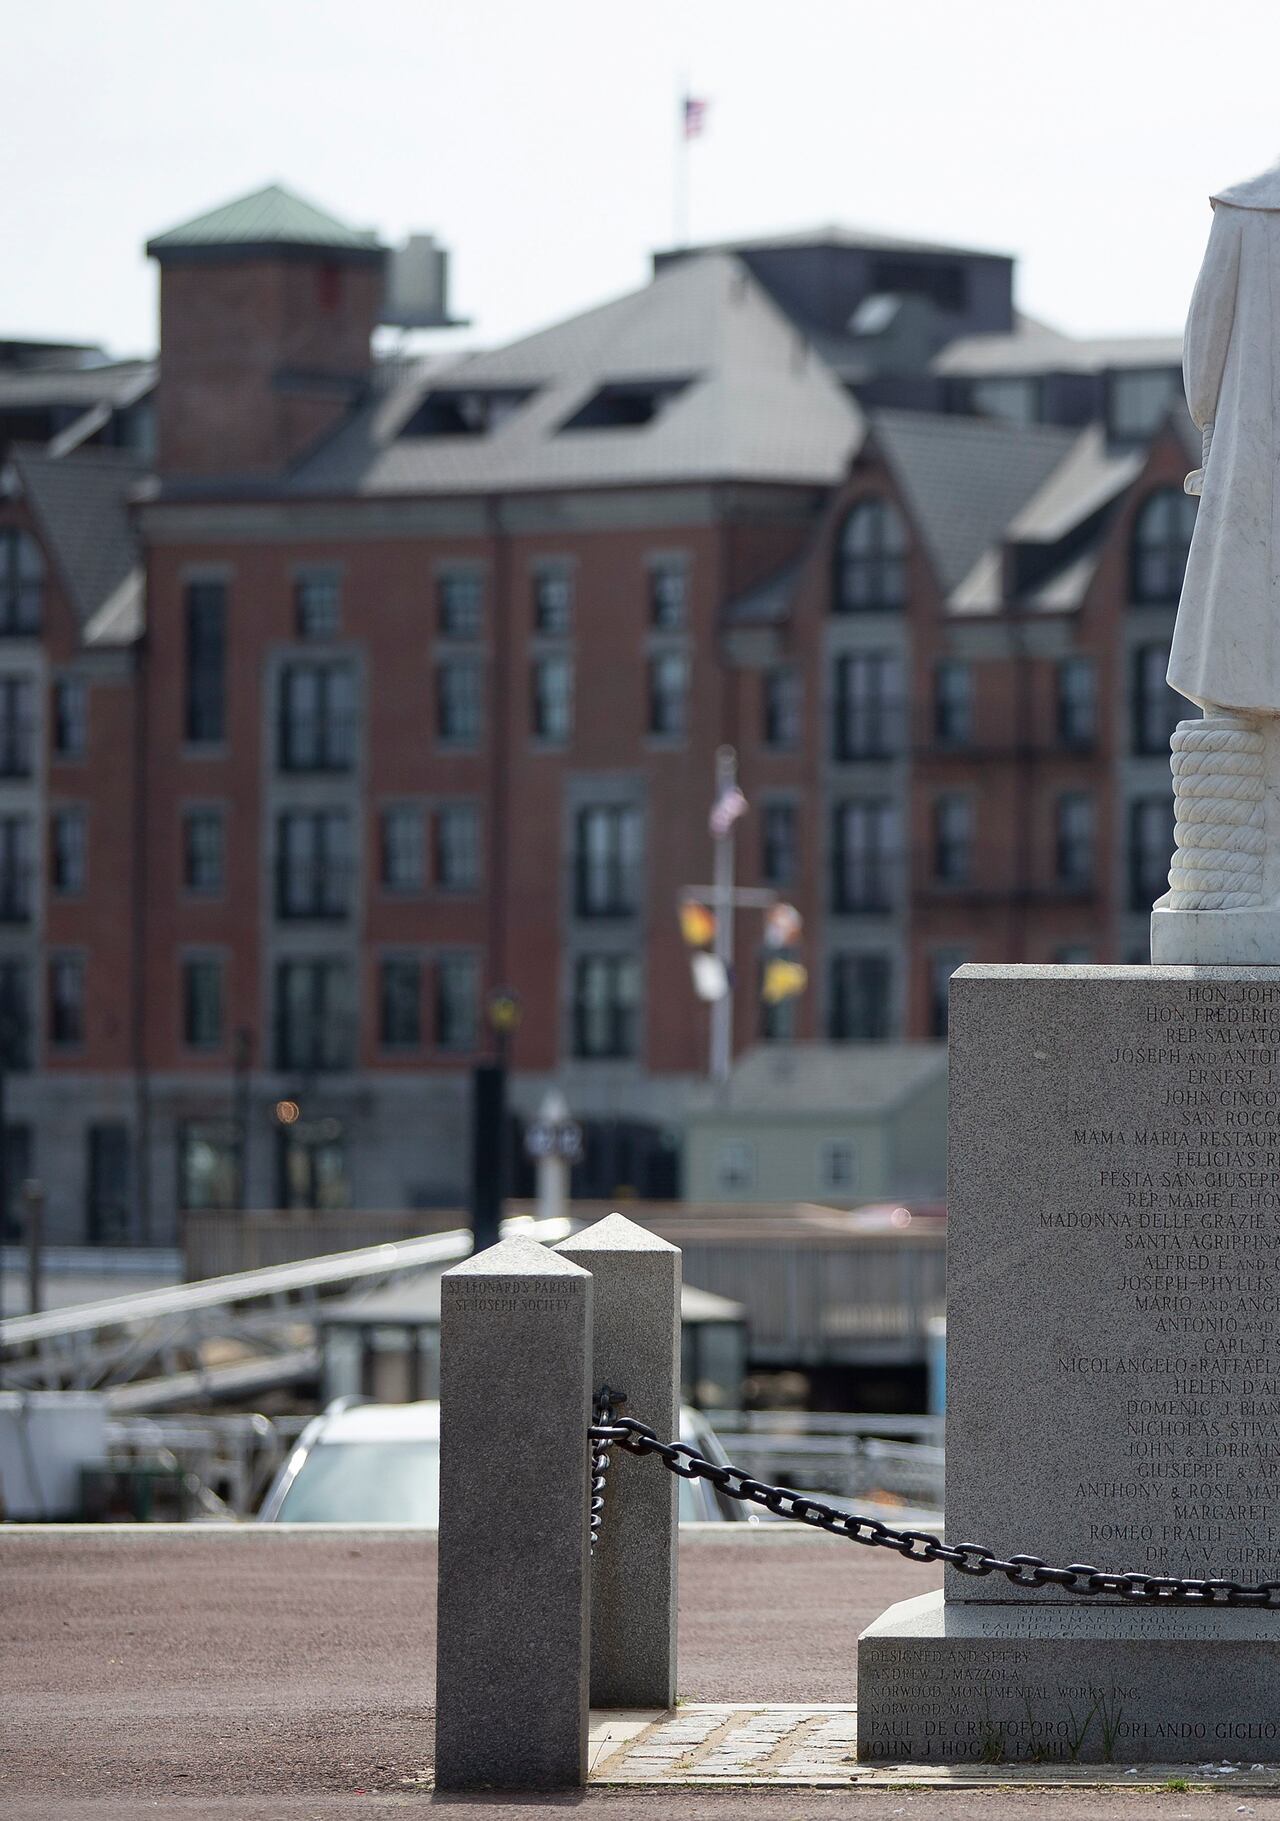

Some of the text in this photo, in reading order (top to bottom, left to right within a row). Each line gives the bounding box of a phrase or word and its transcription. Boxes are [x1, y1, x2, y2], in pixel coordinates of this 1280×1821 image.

[1110, 1049, 1180, 1064] JOSEPH
[1188, 1070, 1254, 1084] ERNEST
[1161, 1091, 1211, 1106] JOHN
[1182, 1111, 1216, 1126] SAN
[1074, 1130, 1126, 1145] MAMA
[1134, 1131, 1189, 1145] MARIA
[1176, 1152, 1256, 1167] FELICIA'S
[1100, 1172, 1153, 1187] FESTA
[1162, 1172, 1195, 1187] SAN
[1169, 1193, 1223, 1208] MARIE
[1040, 1213, 1131, 1228] MADONNA
[1140, 1214, 1194, 1229] DELLE
[1201, 1214, 1266, 1229] GRAZIE
[1125, 1235, 1181, 1249] SANTA
[1144, 1255, 1209, 1270] ALFRED
[535, 1282, 577, 1294] PARISH
[472, 1300, 516, 1311] JOSEPH
[522, 1300, 571, 1311] SOCIETY
[1136, 1297, 1192, 1311] MARIO
[1156, 1317, 1238, 1333] ANTONIO
[1205, 1338, 1247, 1353] CARL
[1175, 1380, 1232, 1394] HELEN
[1127, 1400, 1211, 1416] DOMENIC
[1127, 1421, 1219, 1436] NICHOLAS
[1125, 1442, 1175, 1457] JOHN
[1138, 1463, 1223, 1478] GIUSEPPE
[1075, 1482, 1164, 1498] ANTHONY
[1189, 1483, 1234, 1499] ROSE
[1174, 1505, 1269, 1521] MARGARET
[1090, 1525, 1152, 1541] ROMEO
[871, 1651, 1029, 1664] DESIGNED AND SET BY
[871, 1668, 1019, 1681] ANDREW MAZZOLA
[871, 1686, 941, 1698] NORWOOD
[951, 1686, 1050, 1699] MONUMENTAL
[1058, 1687, 1105, 1699] WORKS
[871, 1721, 1277, 1739] PAUL DE CRISTOFORO ORLANDO GIGLIO
[867, 1741, 912, 1756] JOHN
[942, 1741, 1006, 1756] HOGAN
